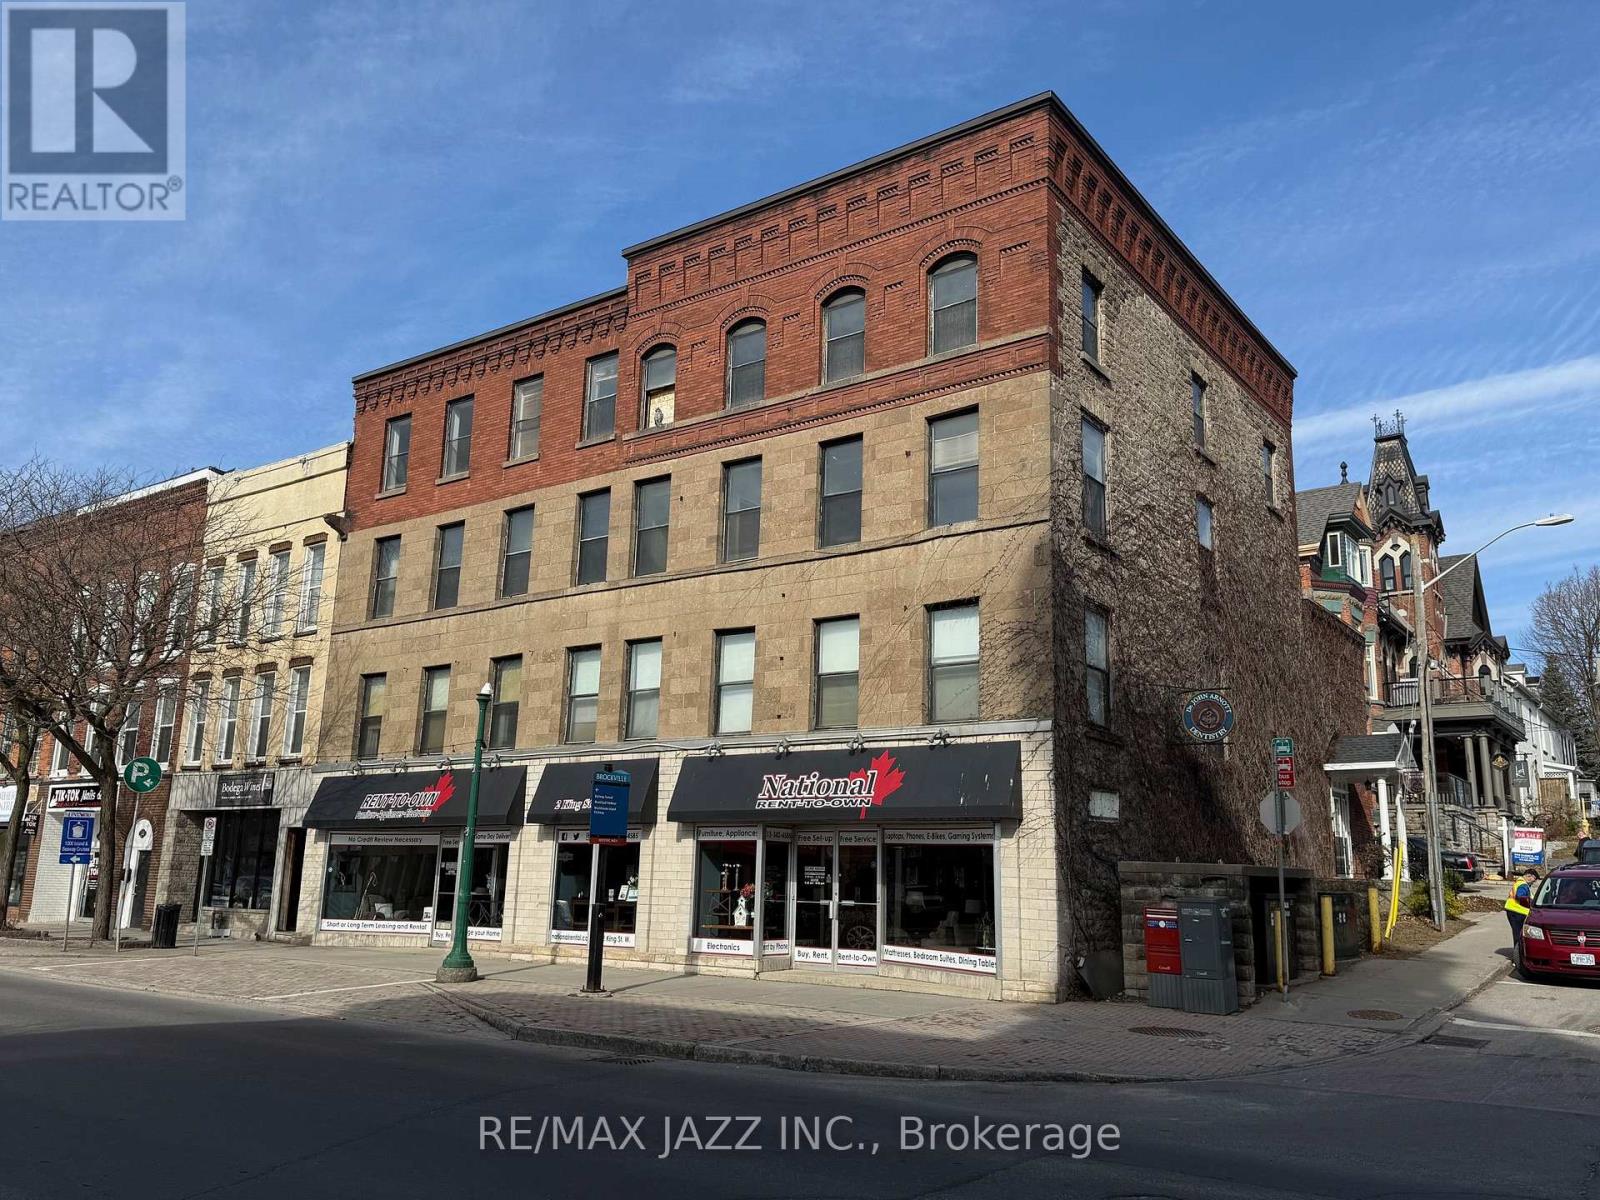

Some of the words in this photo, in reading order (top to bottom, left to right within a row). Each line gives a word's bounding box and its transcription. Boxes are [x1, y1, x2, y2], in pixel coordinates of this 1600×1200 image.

[1191, 693, 1208, 705] JOHN
[1209, 693, 1232, 713] ARNOTT
[1190, 727, 1227, 740] DENTISTRY
[596, 773, 627, 782] BROCKVILLE
[222, 781, 244, 795] Bodega
[244, 782, 261, 792] Wines
[758, 771, 878, 798] National
[360, 791, 440, 809] RENT-TO-OWN
[755, 798, 872, 809] RENT-TO-OWN
[555, 800, 561, 810] 2
[561, 799, 582, 811] King
[394, 836, 423, 844] Necessary
[487, 833, 495, 841] Day
[812, 835, 834, 843] Set-up
[947, 832, 970, 841] Gaming
[347, 922, 360, 930] Long
[607, 935, 617, 943] King
[706, 942, 740, 951] Electronics
[797, 949, 811, 959] Buy,
[838, 952, 877, 961] Rent-to-Own
[913, 951, 938, 961] Bedroom
[958, 956, 977, 968] Dining
